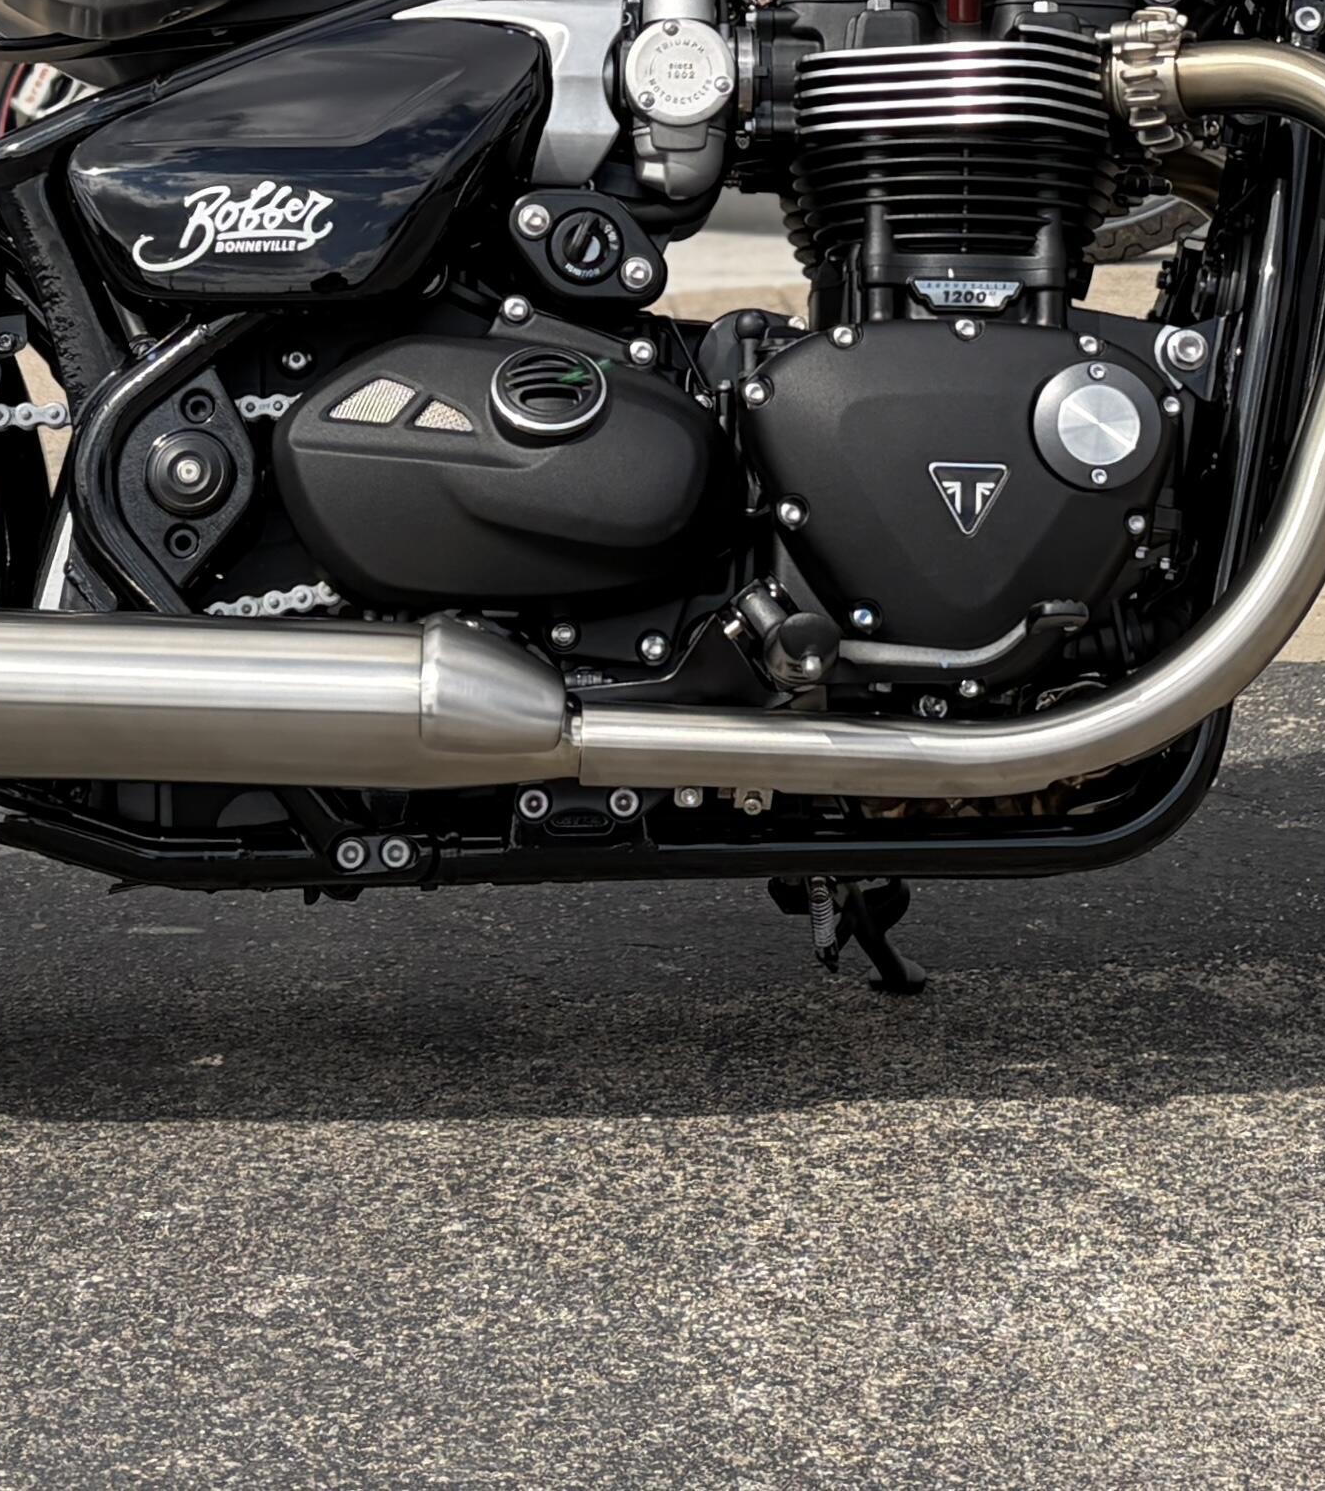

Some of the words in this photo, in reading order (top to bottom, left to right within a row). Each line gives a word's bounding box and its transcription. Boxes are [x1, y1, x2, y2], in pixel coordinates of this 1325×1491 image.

[657, 38, 705, 54] TRIUMPH
[133, 180, 334, 271] Bobber
[215, 239, 296, 253] BONNEVILLE
[943, 290, 987, 304] 1200
